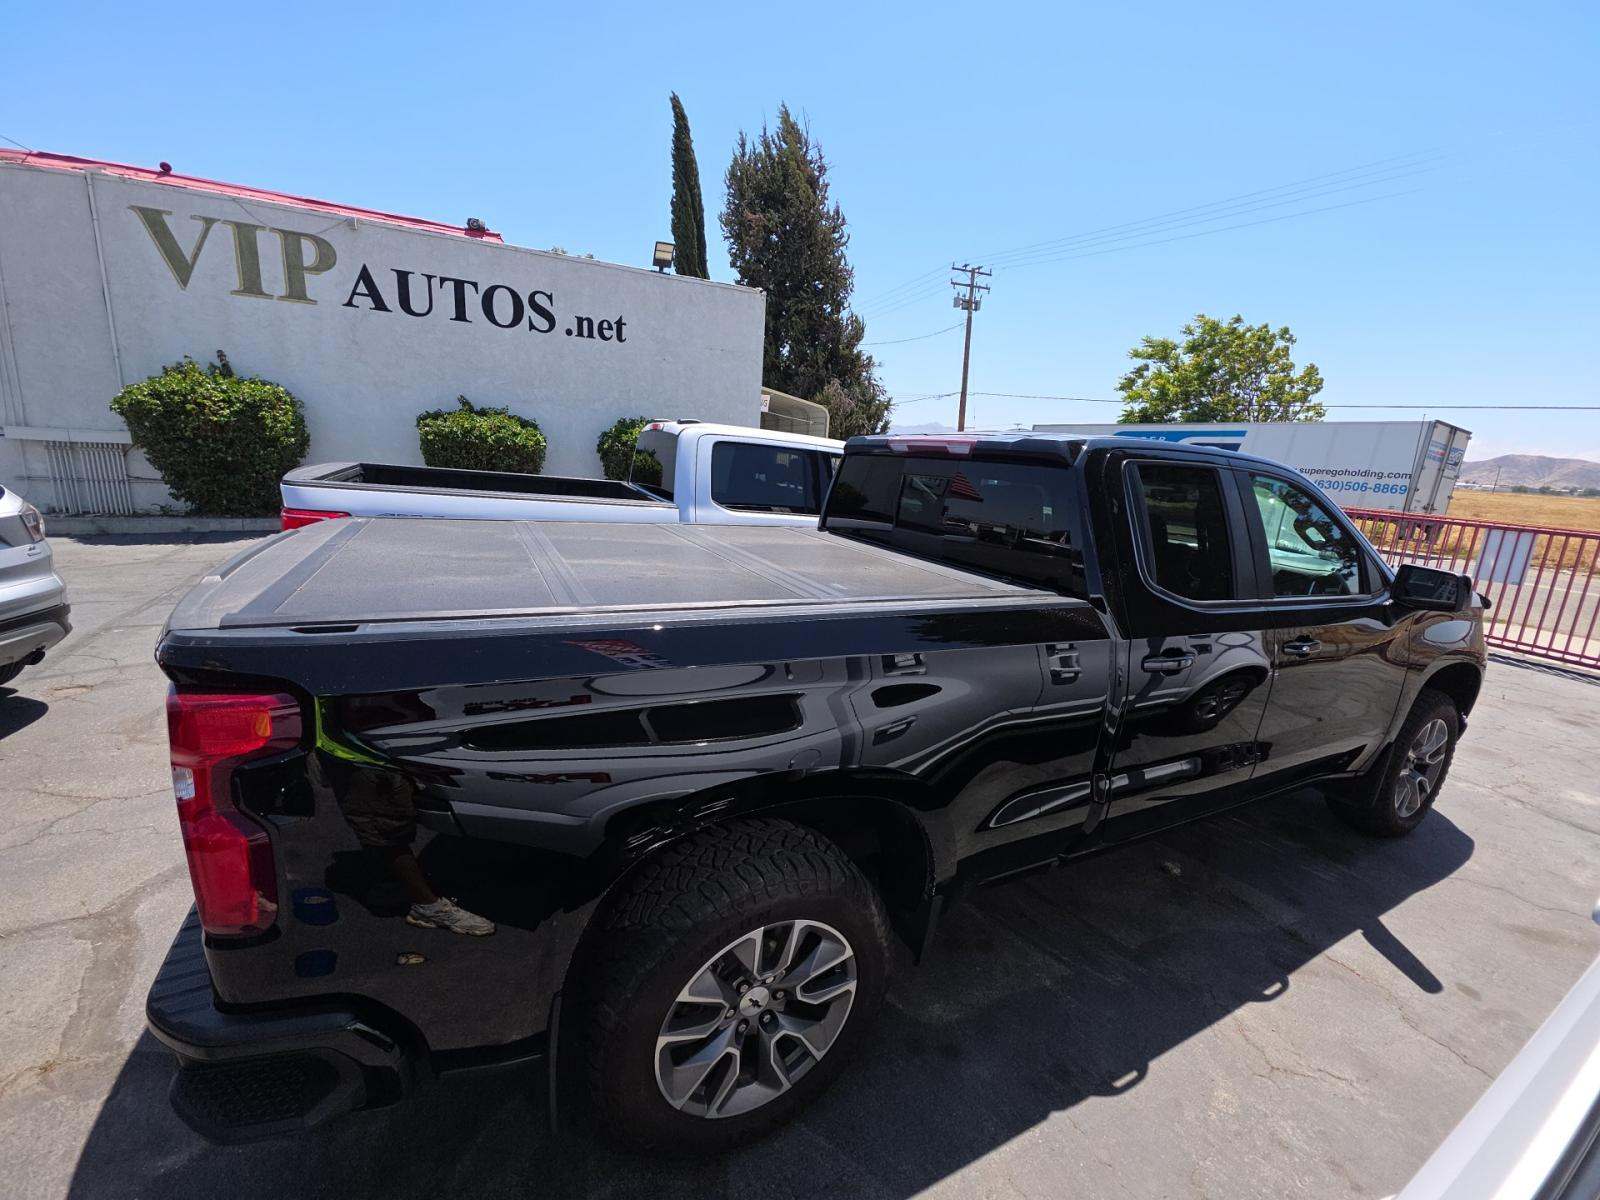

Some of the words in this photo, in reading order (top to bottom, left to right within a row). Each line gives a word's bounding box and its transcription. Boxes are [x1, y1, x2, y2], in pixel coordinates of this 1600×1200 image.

[127, 204, 338, 305] VIP
[342, 263, 557, 334] AUTOS
[564, 313, 628, 343] .net
